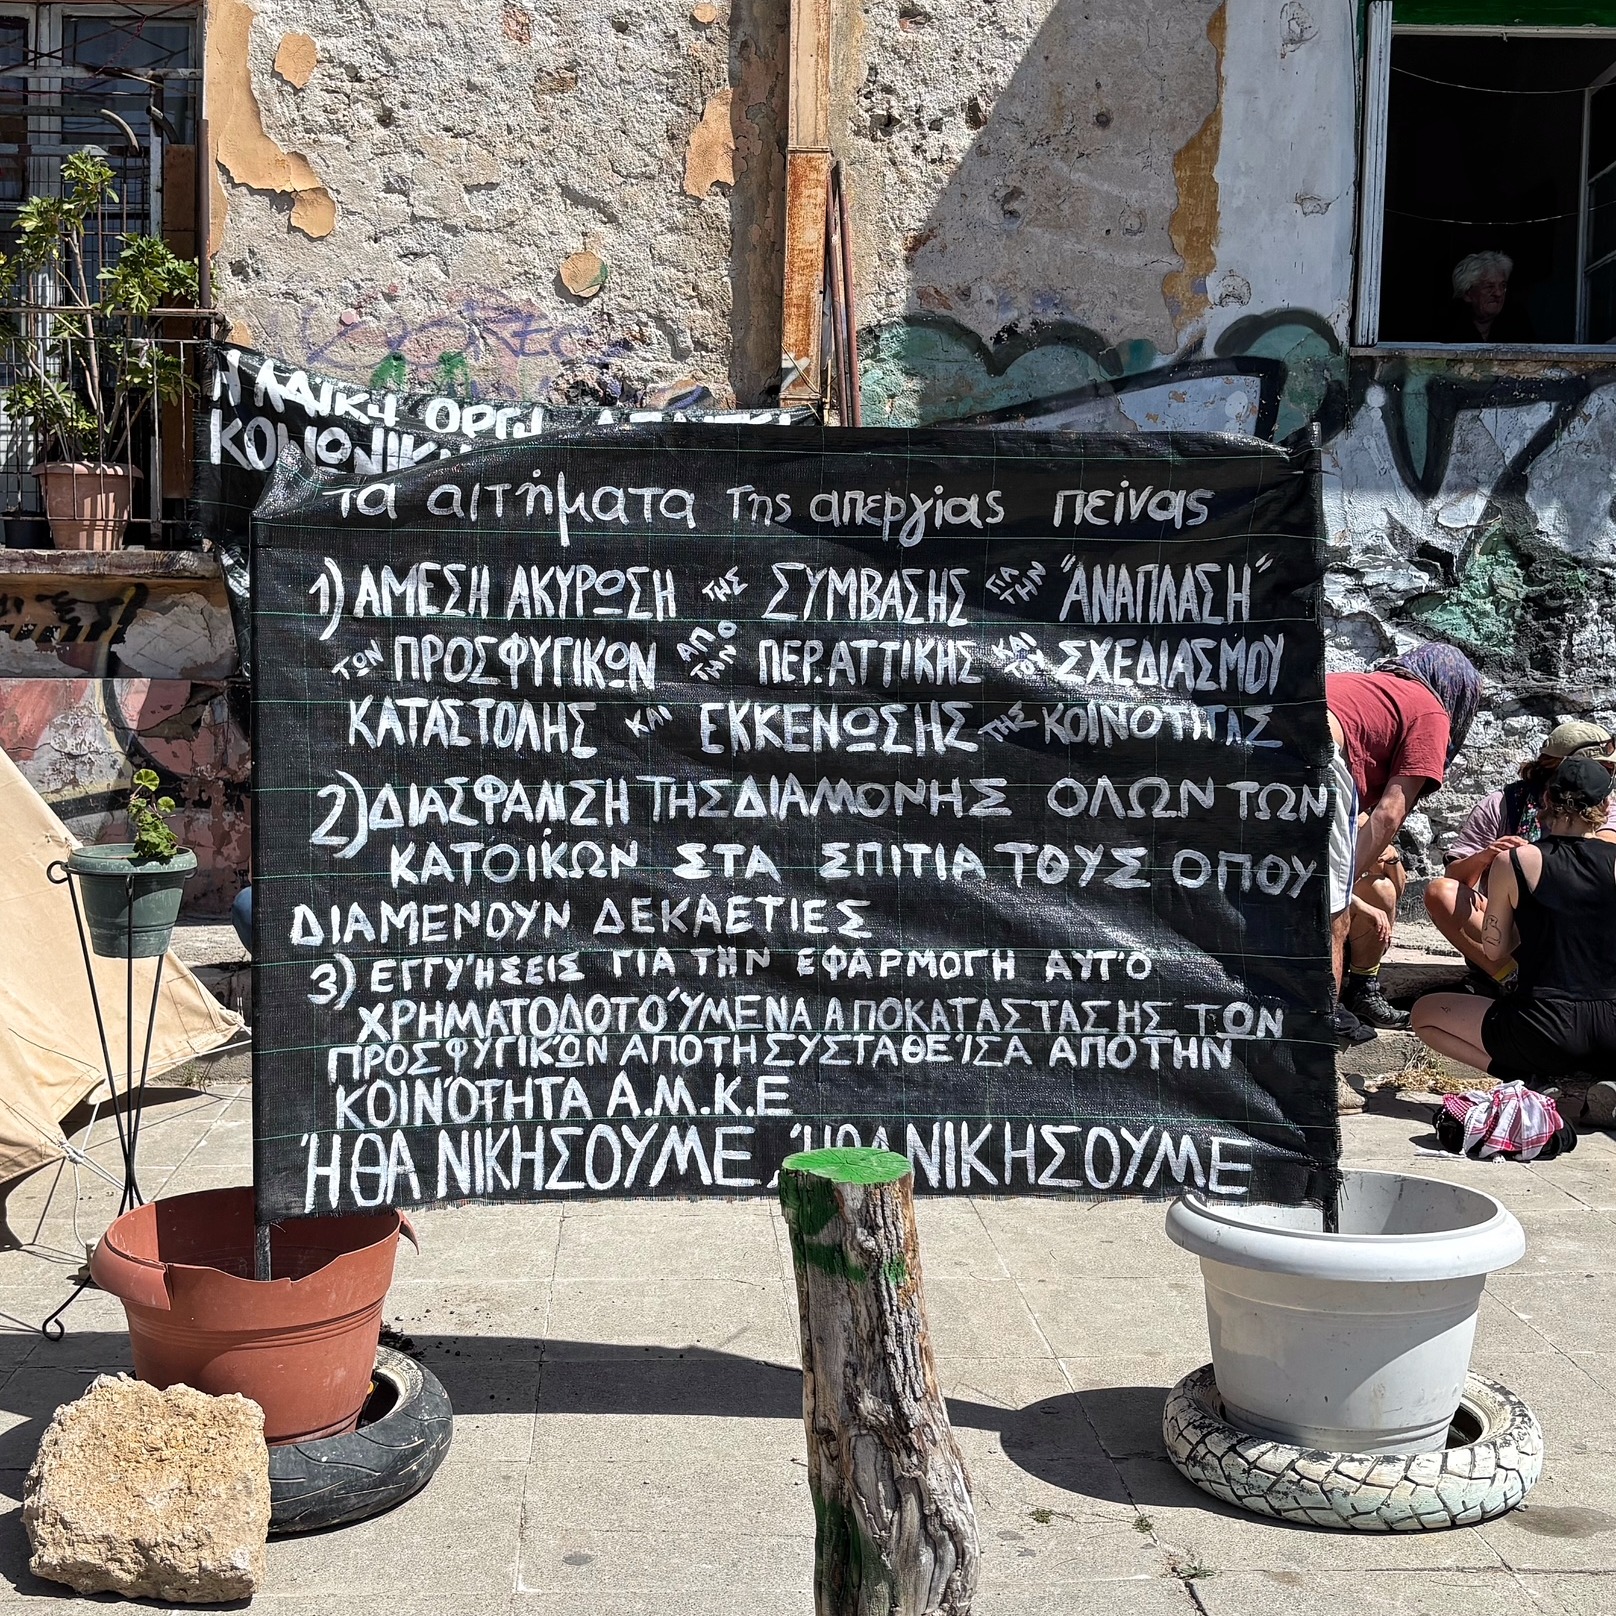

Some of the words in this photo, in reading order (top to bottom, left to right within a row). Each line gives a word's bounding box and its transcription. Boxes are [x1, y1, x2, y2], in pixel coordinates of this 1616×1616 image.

[810, 485, 1005, 548] απεργίας
[1053, 479, 1215, 530] πείνας
[308, 557, 344, 640] 1)
[354, 562, 490, 619] ΑΜΕΣΗ
[507, 564, 676, 622] ΑΚΥΡΩΣΗ
[702, 565, 748, 602] ΤΗΣ
[761, 562, 970, 627] ΣΥΜΒΑΣΗΣ
[986, 566, 1020, 595] ΓΙΑ
[1000, 561, 1046, 605] ΤΗΝ
[331, 639, 384, 680] ΤΩΝ
[395, 632, 656, 692] ΠΡΟΣΦΥΓΙΚΩΝ
[690, 643, 737, 682] ΤΗΝ
[1056, 633, 1284, 695] ΣΧΕΔΙΑΣΜΟΥ
[348, 694, 597, 759] ΚΑΤΑΣΤΟΛΗΣ
[624, 705, 673, 738] ΚΑΙ
[701, 699, 979, 757] ΕΚΚΕΝΩΣΗΣ
[977, 700, 1040, 742] ΤΗΣ
[1047, 775, 1214, 819] ΟΛΩΝ
[1225, 780, 1328, 821] ΤΩΝ
[672, 843, 782, 885] ΣΤΑ
[819, 841, 987, 881] ΣΠΙΤΙΑ
[994, 841, 1151, 888] ΤΟΥΣ
[1172, 850, 1316, 898] ΟΠΟΥ
[291, 900, 570, 946] ΔΙΑΜΕΝΟΥΝ
[593, 894, 871, 938] ΔΕΚΑΕΤΙΕΣ
[307, 953, 356, 1010] 3)
[612, 946, 676, 978] ΓΙΑ
[691, 945, 770, 978] ΤΗΝ
[797, 945, 1015, 981] ΕΦΑΡΜΟΓΗ
[1184, 1001, 1283, 1040] ΤΩΝ
[907, 1120, 1253, 1195] ΝΙΚΗΣΟΥΜΕ
